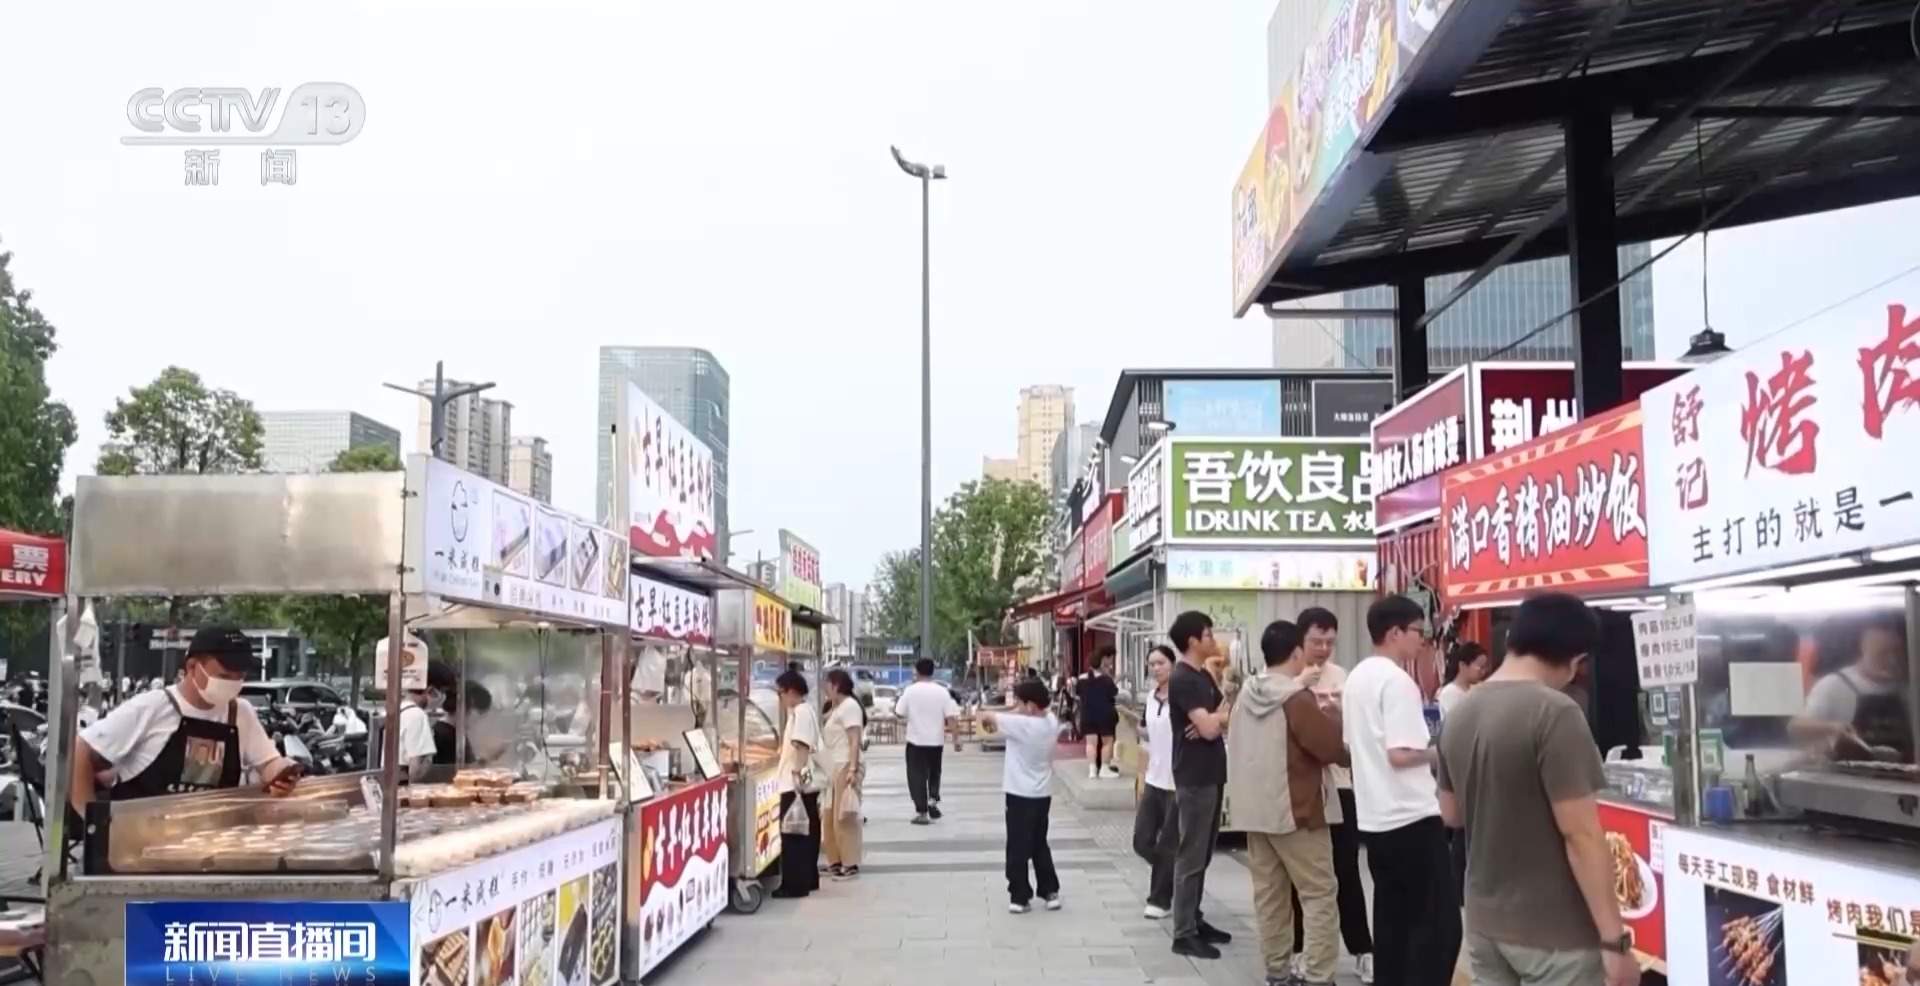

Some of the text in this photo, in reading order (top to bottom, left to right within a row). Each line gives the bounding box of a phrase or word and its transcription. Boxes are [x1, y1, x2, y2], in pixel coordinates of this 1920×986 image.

[1186, 510, 1281, 532] IDRINK
[1284, 510, 1337, 532] TEA
[1450, 452, 1647, 572] 满口香猪油炒饭
[1692, 486, 1914, 563] 主打的就是一
